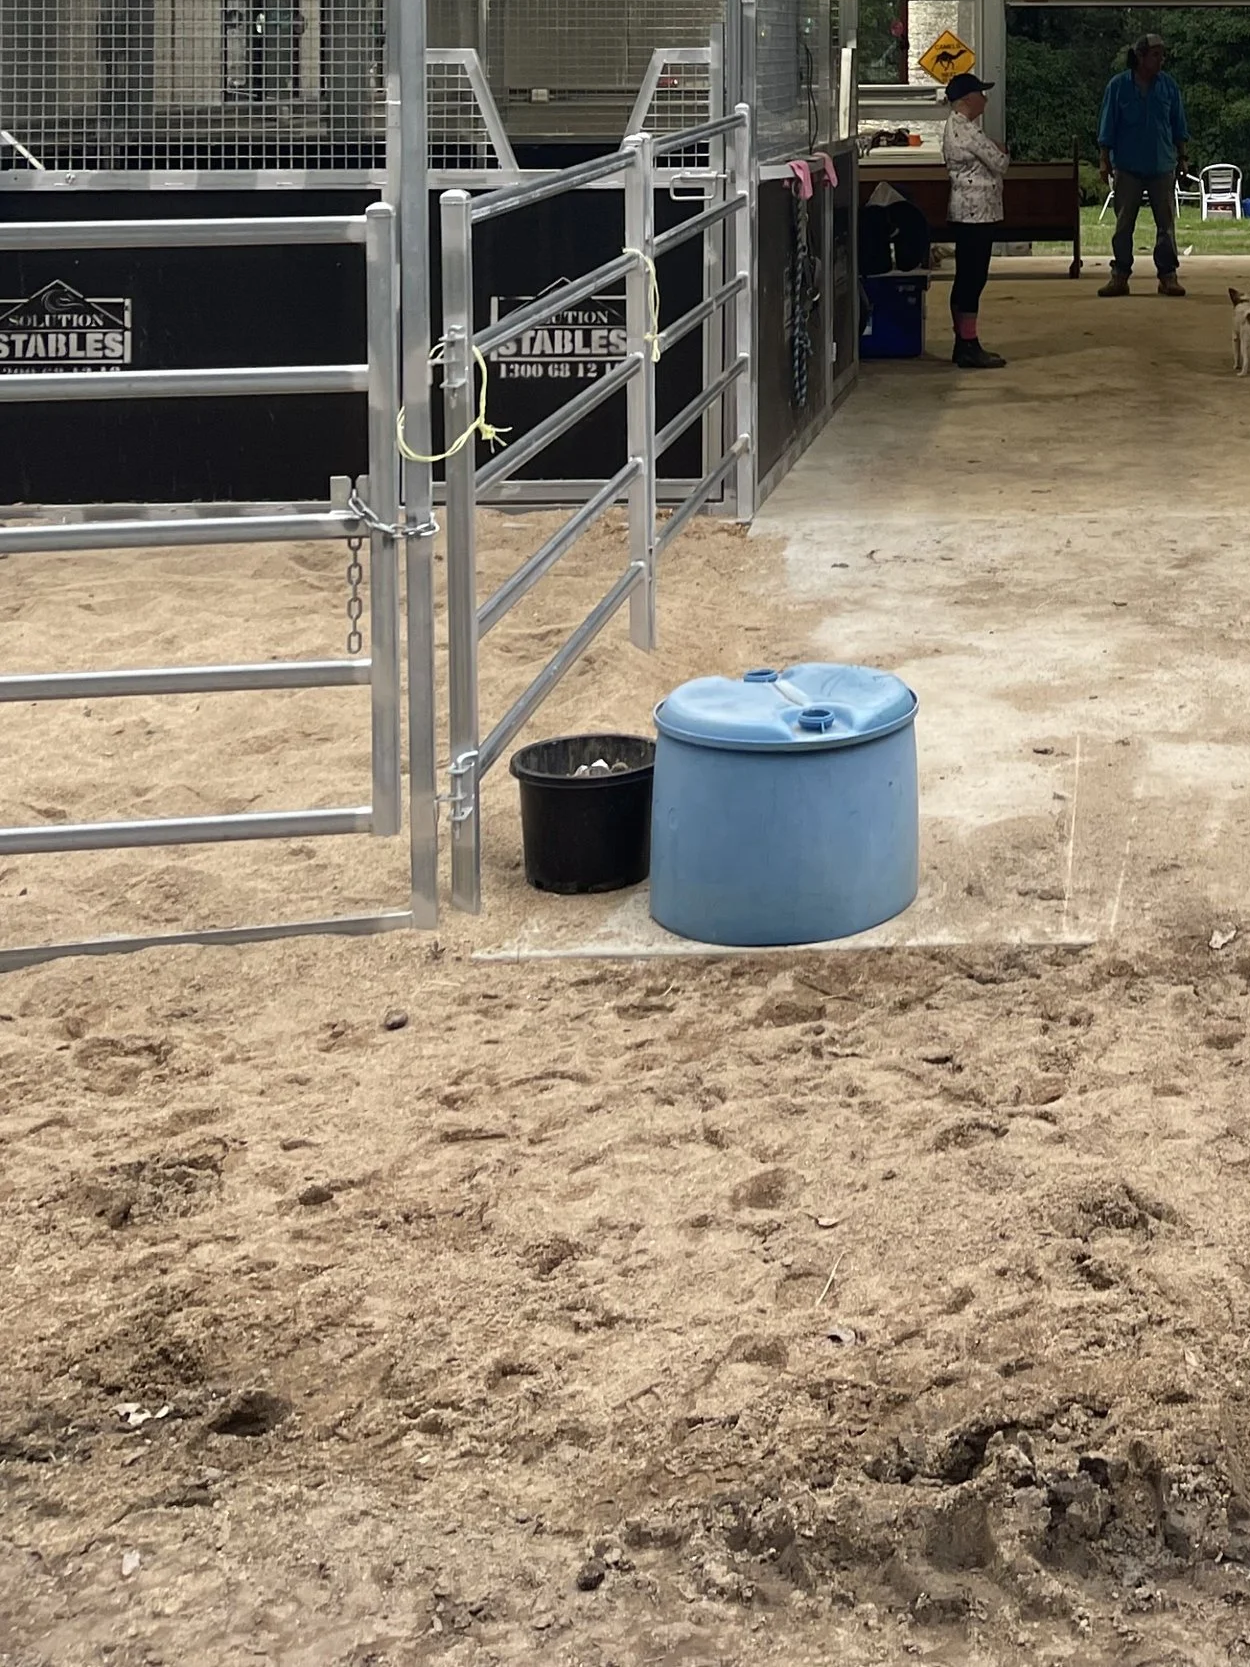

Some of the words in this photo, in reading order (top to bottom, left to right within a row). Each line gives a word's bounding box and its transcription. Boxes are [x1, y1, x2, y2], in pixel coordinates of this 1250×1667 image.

[8, 314, 104, 327] SOLUTION
[547, 311, 609, 324] UTION
[498, 329, 627, 355] STABLES
[499, 363, 543, 378] 1300
[547, 363, 571, 378] 68
[577, 362, 598, 378] 12
